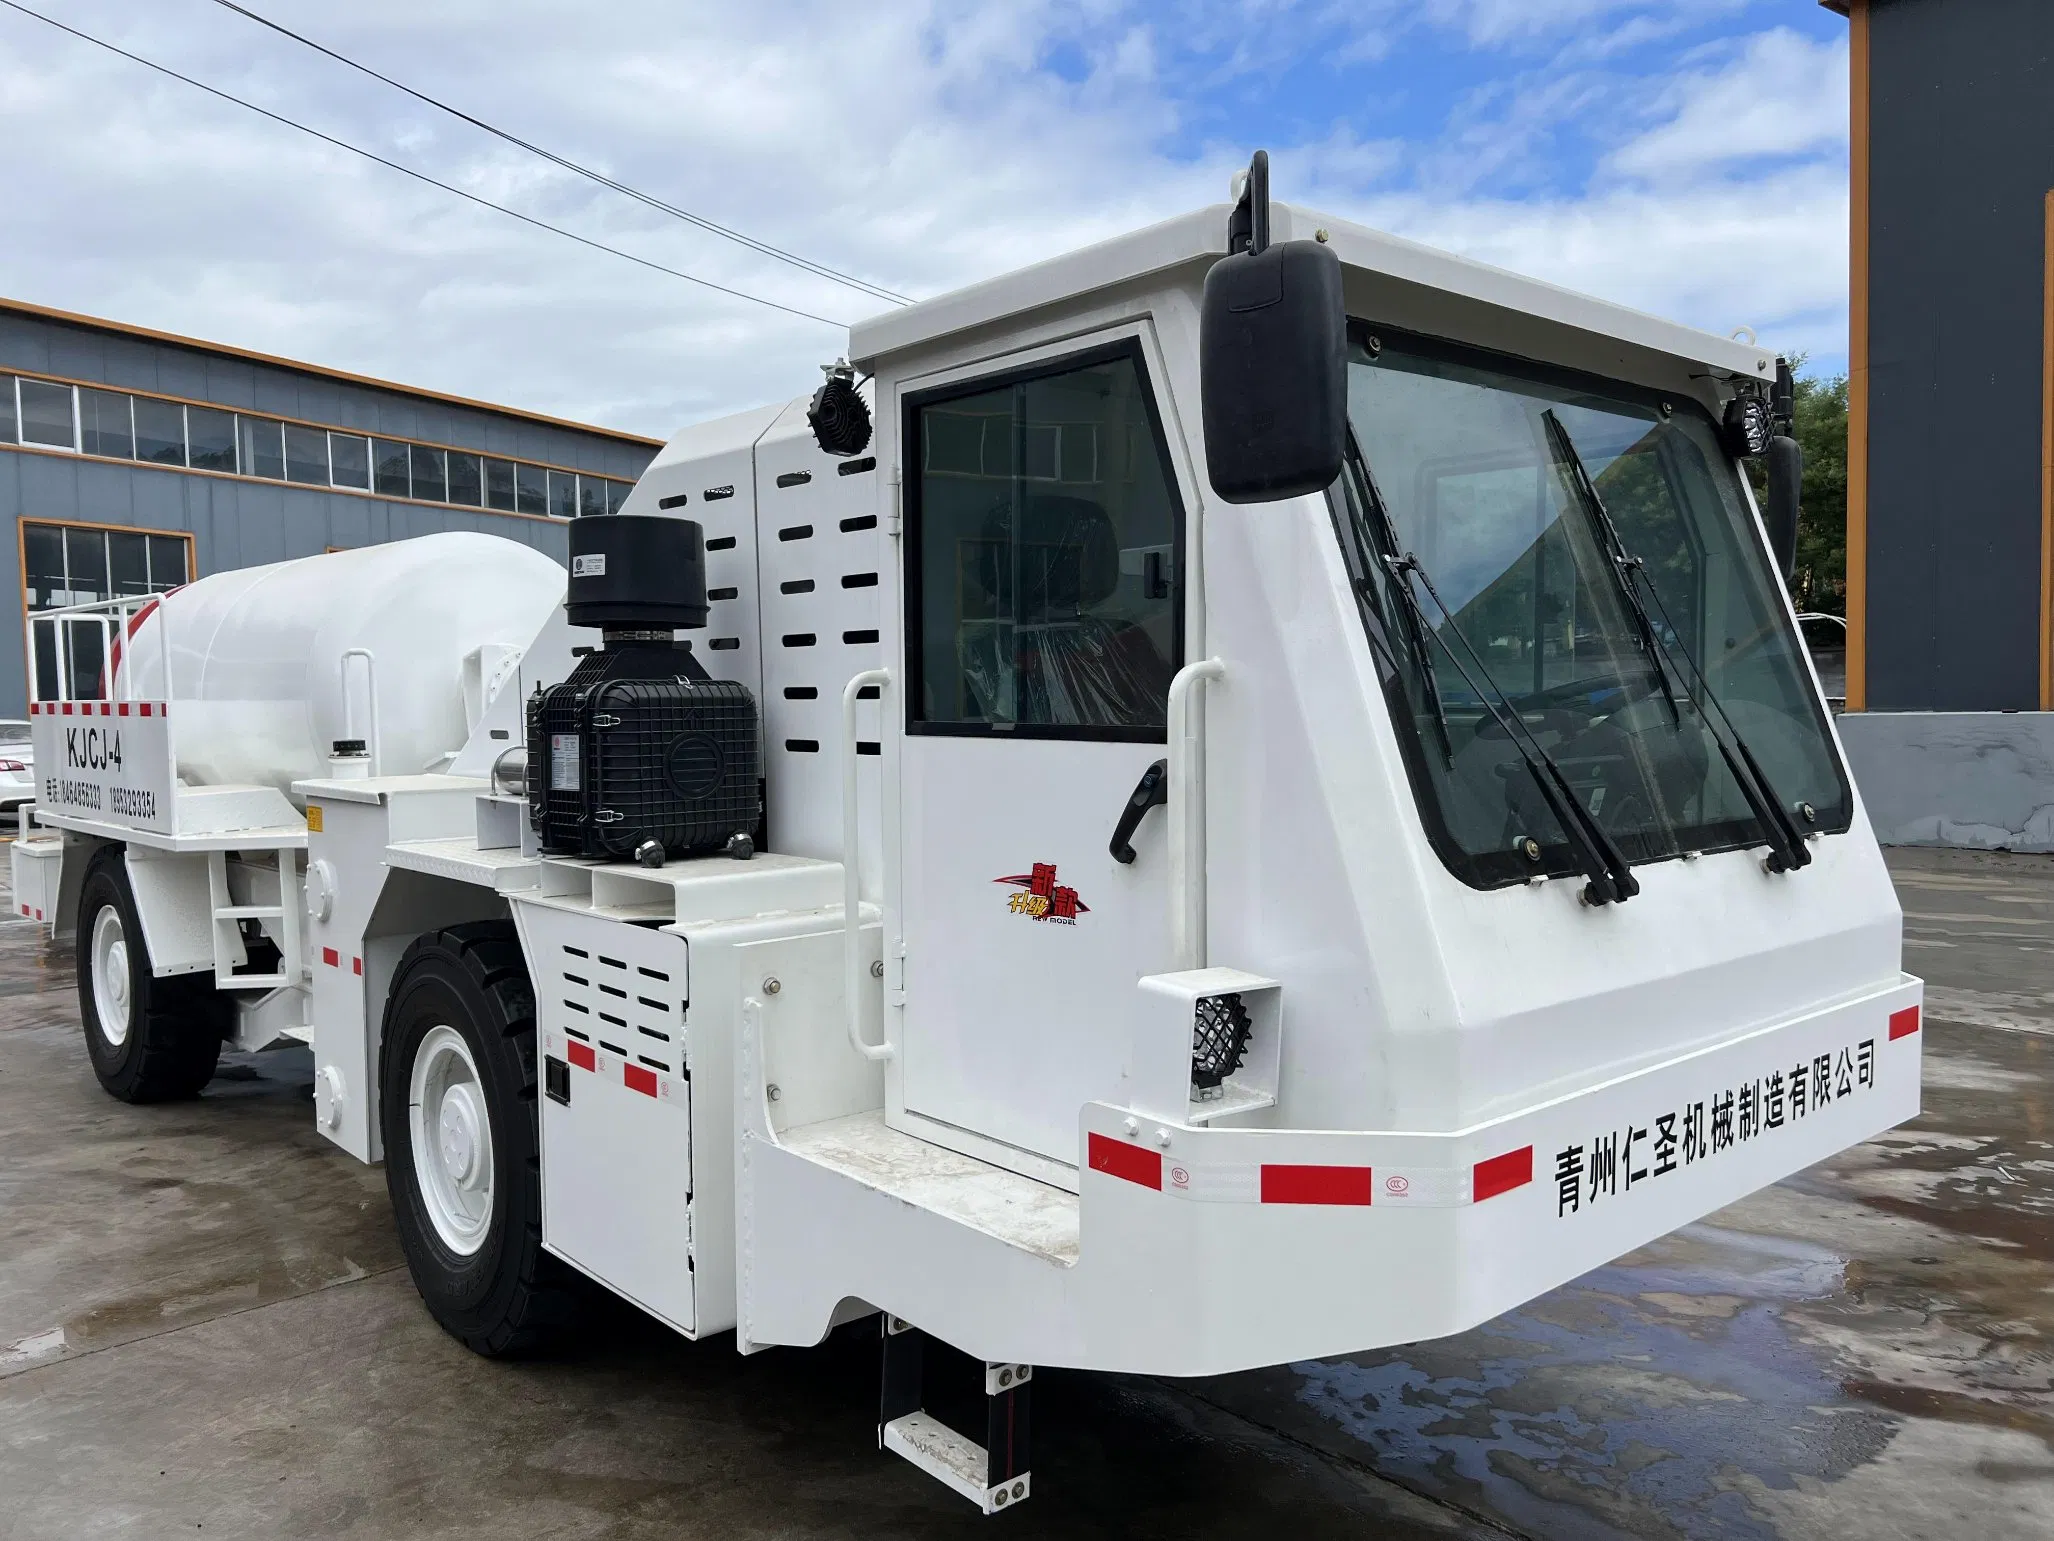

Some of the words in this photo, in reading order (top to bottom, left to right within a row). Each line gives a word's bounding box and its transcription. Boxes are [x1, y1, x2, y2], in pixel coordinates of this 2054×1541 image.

[66, 727, 122, 773] KJCJ-4
[1007, 889, 1049, 916] 升级
[1049, 917, 1077, 926] MODEL
[1554, 1038, 1875, 1218] 青州仁圣机械制造有限公司
